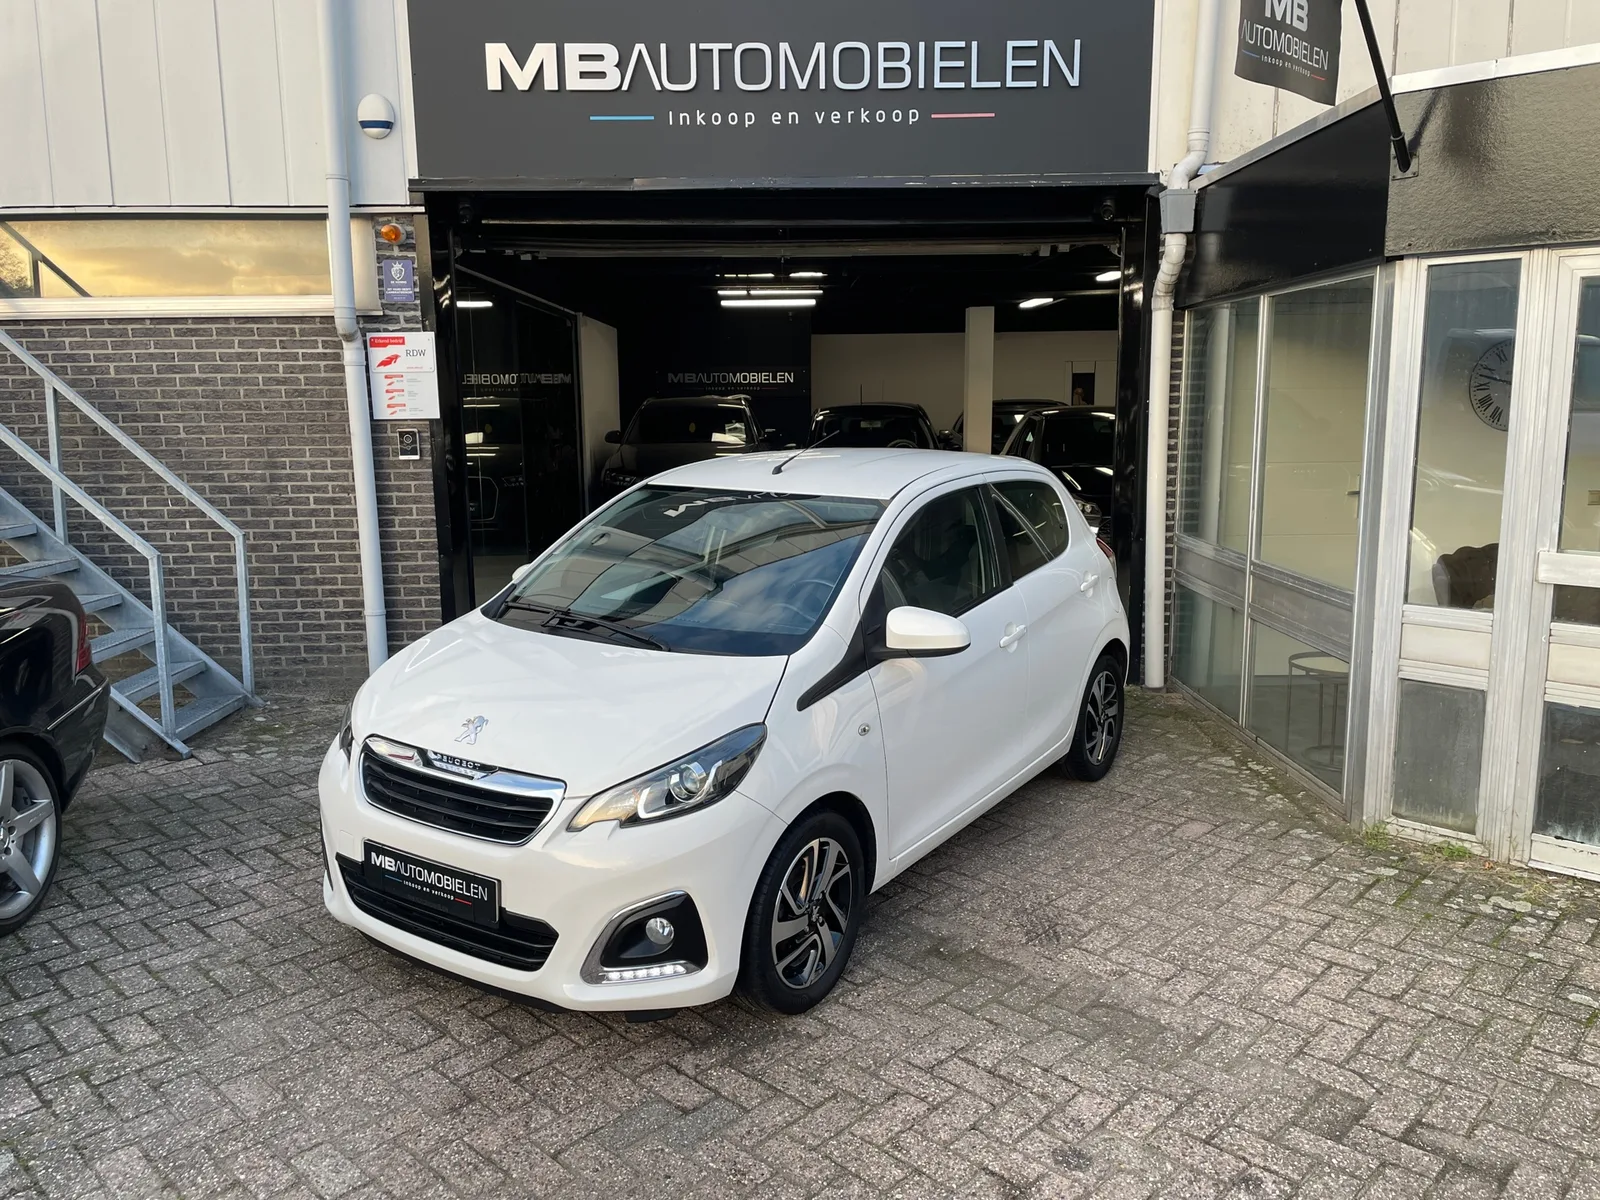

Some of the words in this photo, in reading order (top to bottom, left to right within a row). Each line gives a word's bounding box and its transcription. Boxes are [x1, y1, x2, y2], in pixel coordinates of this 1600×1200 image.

[1264, 0, 1309, 32] MB
[1241, 19, 1329, 70] AUTOMOBIELEN
[771, 111, 799, 125] en
[814, 107, 920, 125] verkoop
[405, 349, 426, 357] RDW
[436, 752, 481, 770] PEUGEOT
[431, 889, 455, 901] verkoop
